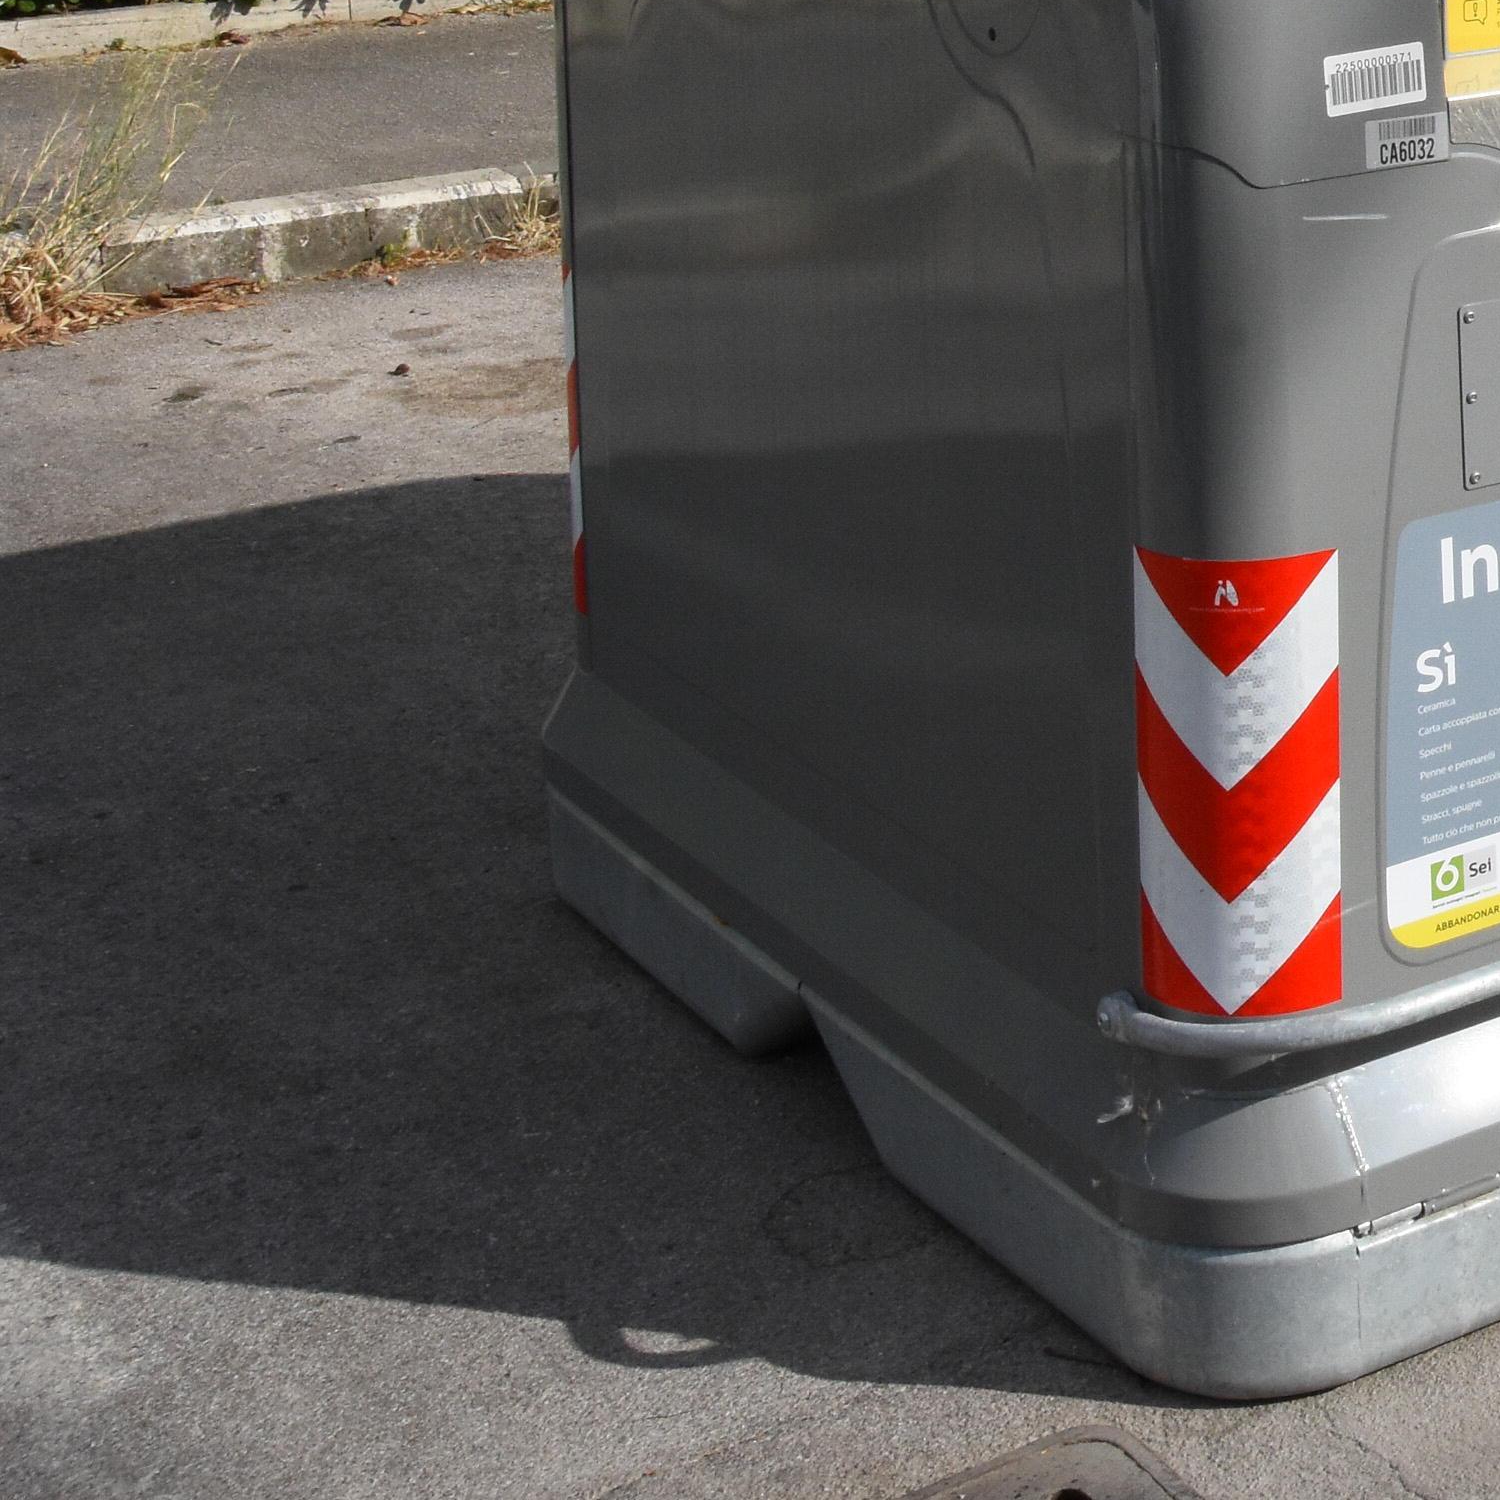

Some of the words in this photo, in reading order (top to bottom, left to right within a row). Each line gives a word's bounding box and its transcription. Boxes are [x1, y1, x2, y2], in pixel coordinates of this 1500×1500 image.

[1336, 52, 1412, 73] 22500000371
[1380, 138, 1434, 165] CA6032
[1416, 641, 1456, 692] Sì
[1417, 699, 1455, 714] Ceramica
[1418, 724, 1439, 735] Carta
[1442, 711, 1486, 728] accoppiata
[1419, 741, 1451, 757] Specchi
[1420, 767, 1445, 779] Penne
[1455, 751, 1495, 770] pennarelli
[1420, 785, 1457, 801] Spazzole
[1453, 800, 1481, 813] spugne
[1422, 833, 1443, 844] Tutto
[1459, 824, 1472, 833] che
[1476, 819, 1492, 828] non
[1469, 858, 1491, 876] Sei
